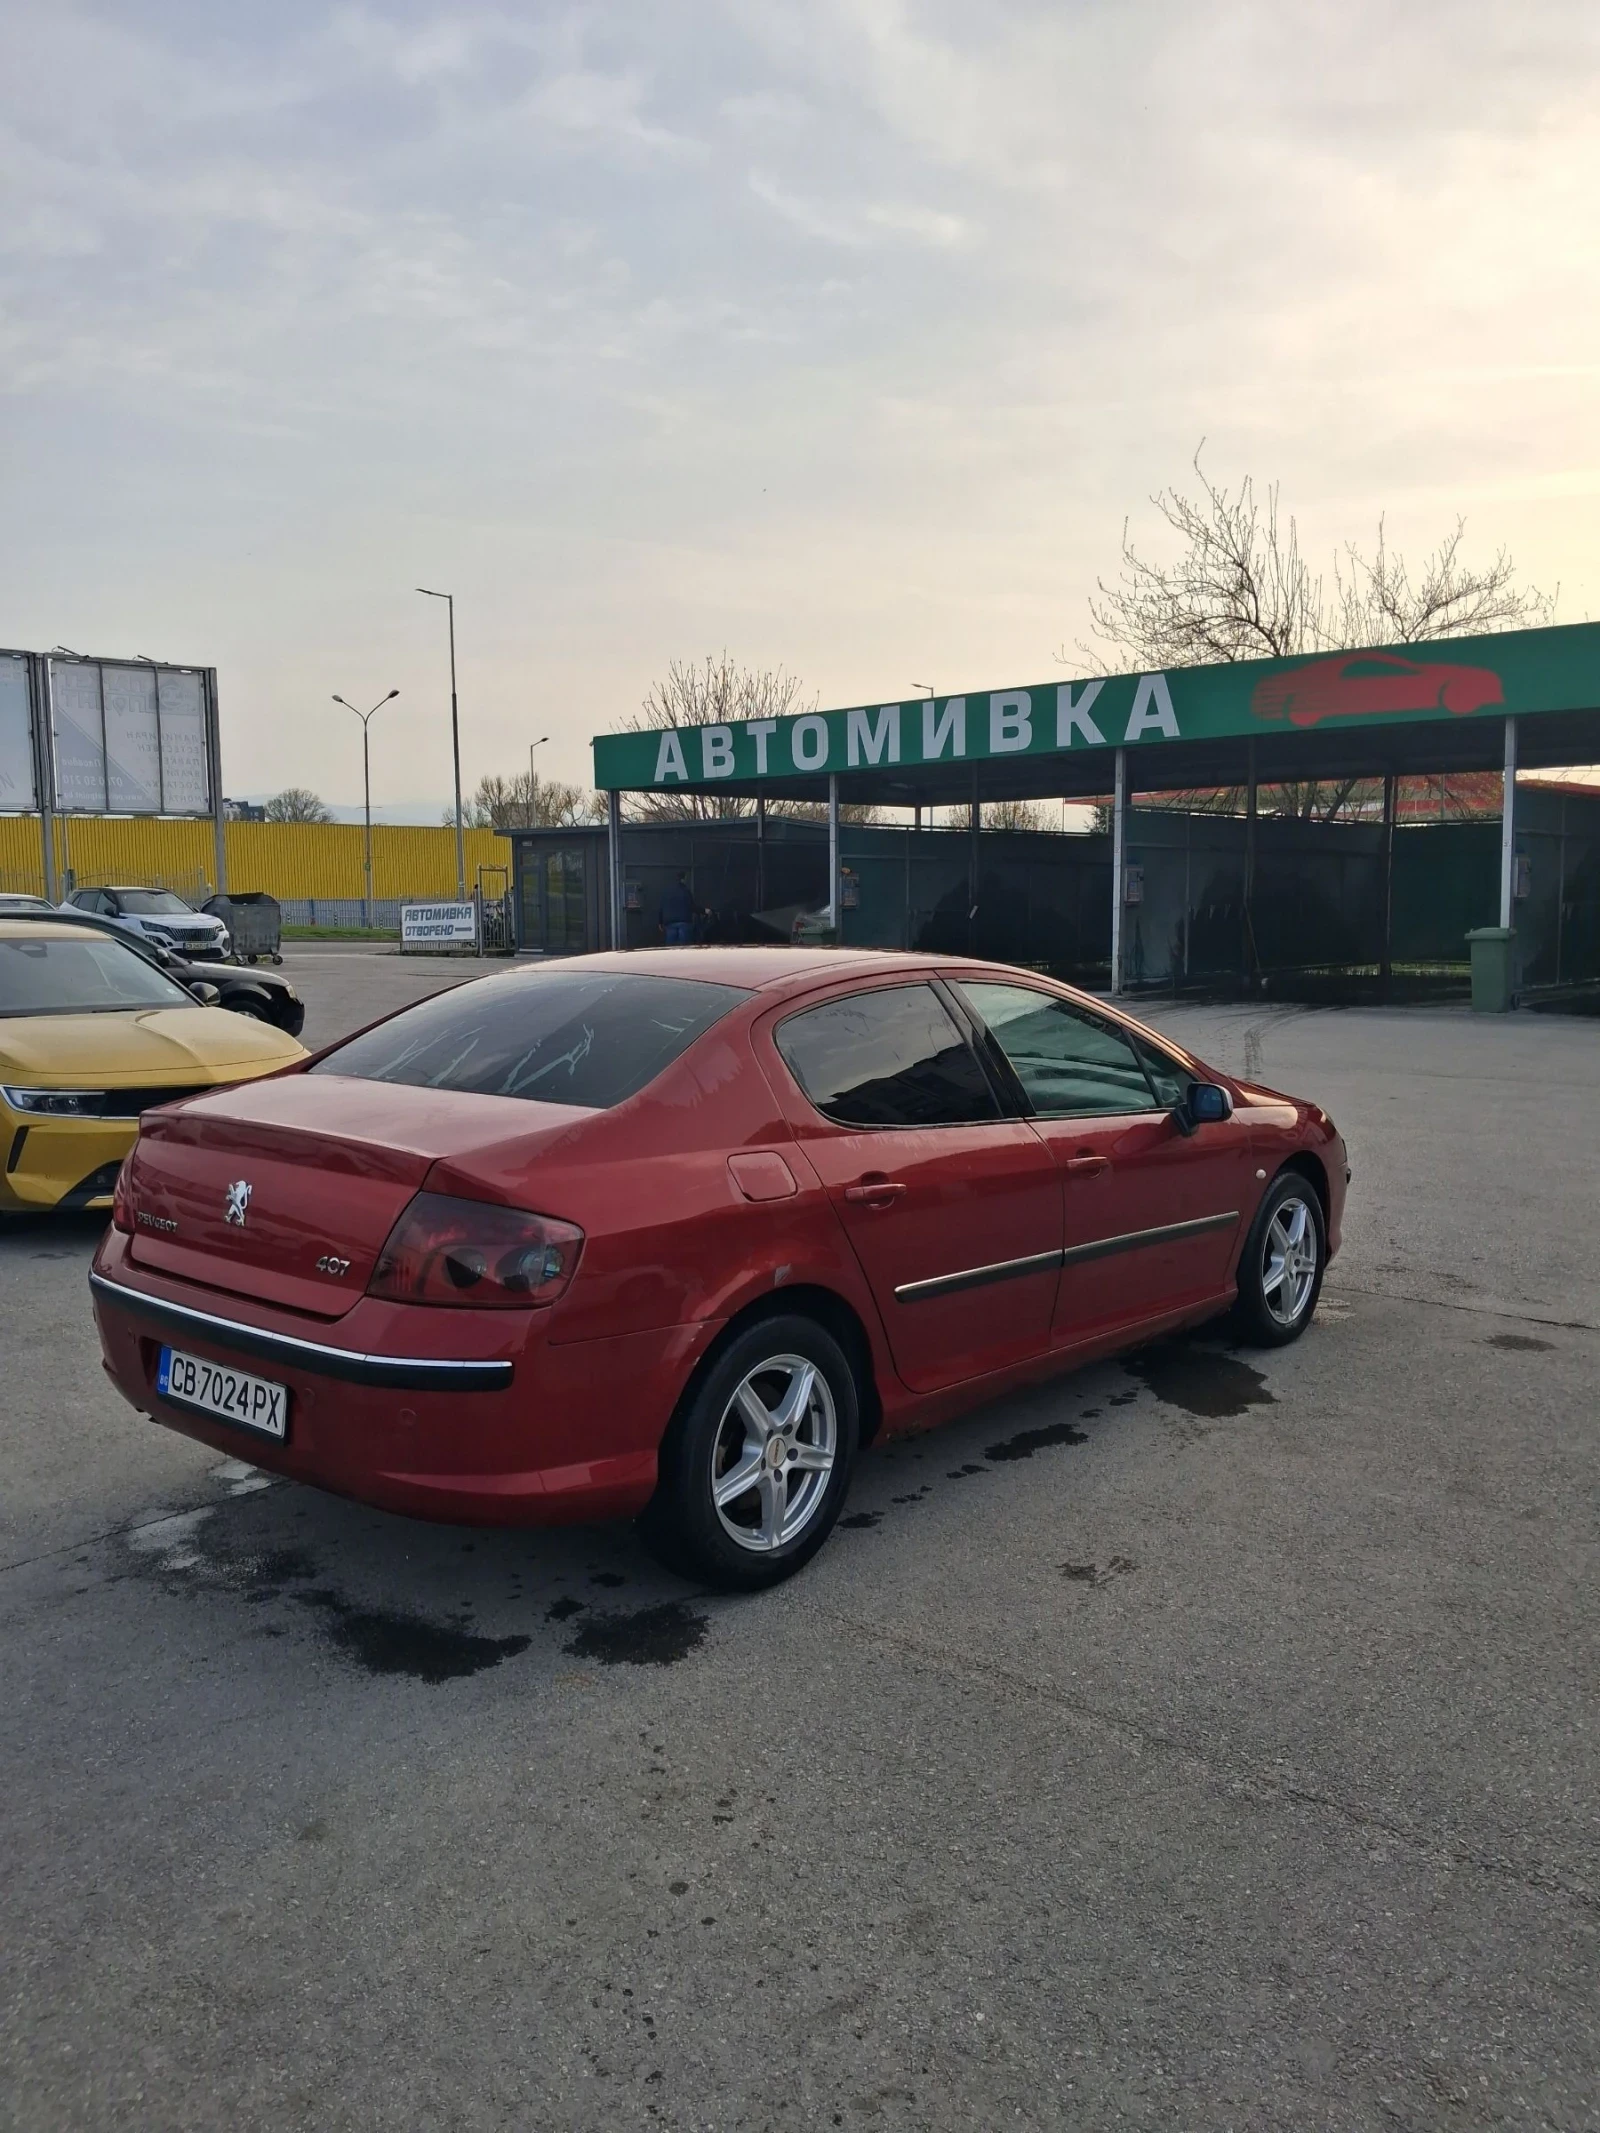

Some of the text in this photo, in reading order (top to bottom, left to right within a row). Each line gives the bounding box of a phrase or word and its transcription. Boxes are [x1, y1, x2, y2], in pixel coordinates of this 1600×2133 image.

[653, 673, 1181, 782] АВТОМИВКА
[404, 907, 472, 921] АВТОМИВКА
[405, 925, 454, 936] ОТВОРЕНО
[137, 1211, 178, 1233] PEUGEOT
[315, 1256, 350, 1276] 407
[160, 1374, 169, 1386] BG
